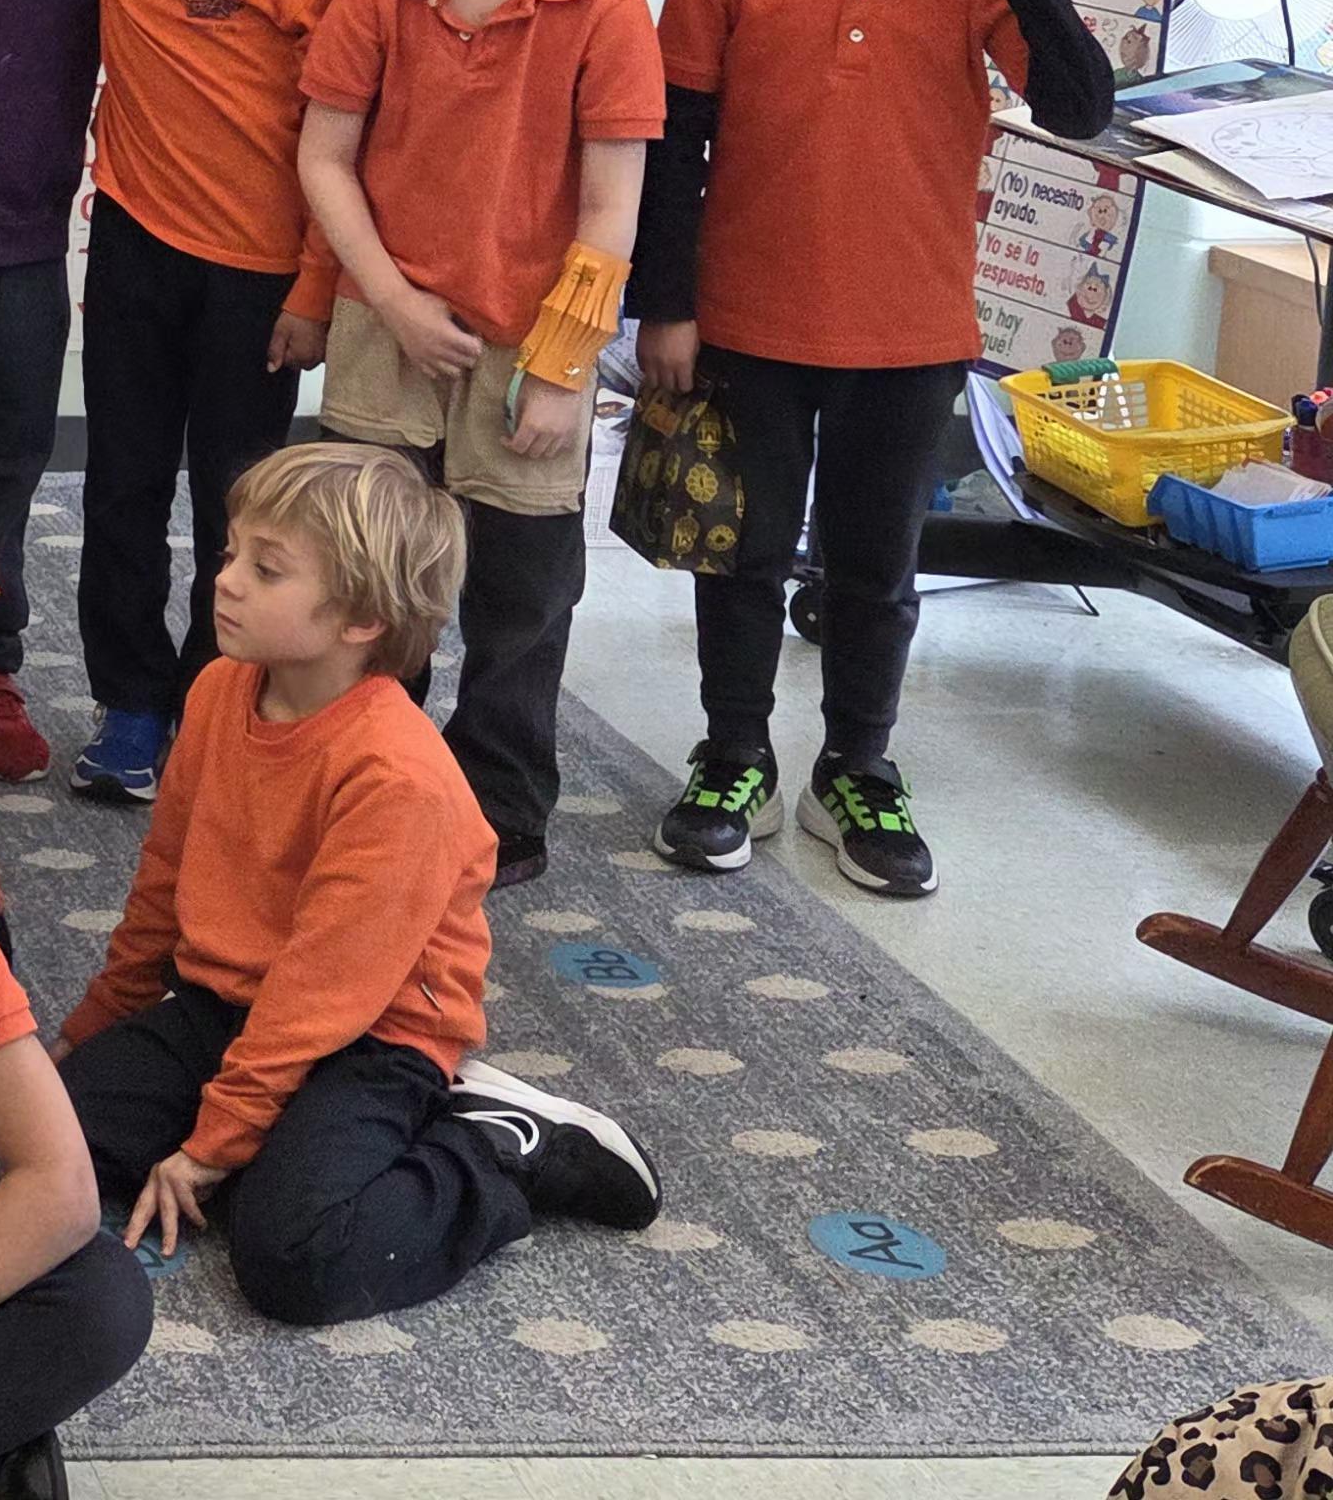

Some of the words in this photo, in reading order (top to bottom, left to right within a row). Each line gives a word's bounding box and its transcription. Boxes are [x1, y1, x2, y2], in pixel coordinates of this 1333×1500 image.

[1001, 172, 1029, 198] (Yo)
[1031, 182, 1084, 211] necesito
[985, 232, 1000, 253] Yo
[573, 950, 639, 980] Bb
[848, 1222, 925, 1270] Aa
